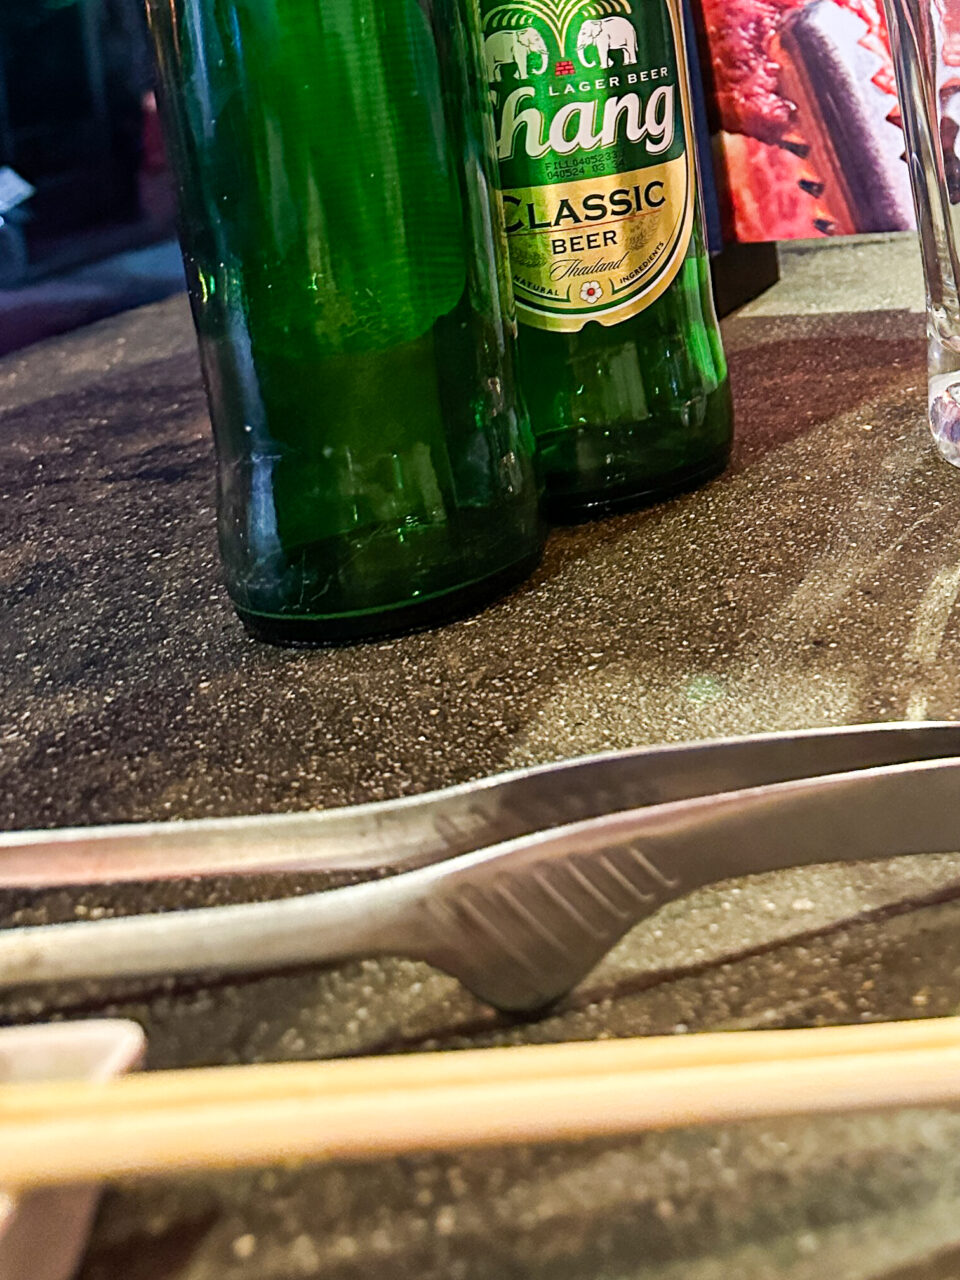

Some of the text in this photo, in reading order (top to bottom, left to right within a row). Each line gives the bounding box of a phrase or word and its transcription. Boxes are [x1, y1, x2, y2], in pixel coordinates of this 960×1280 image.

[548, 66, 669, 97] LAGER BEER
[489, 83, 675, 162] hang
[502, 180, 666, 233] CLASSIC
[551, 230, 618, 254] BEER
[513, 241, 665, 297] NATURAL INGREDIENTS
[550, 251, 630, 281] Thailand
